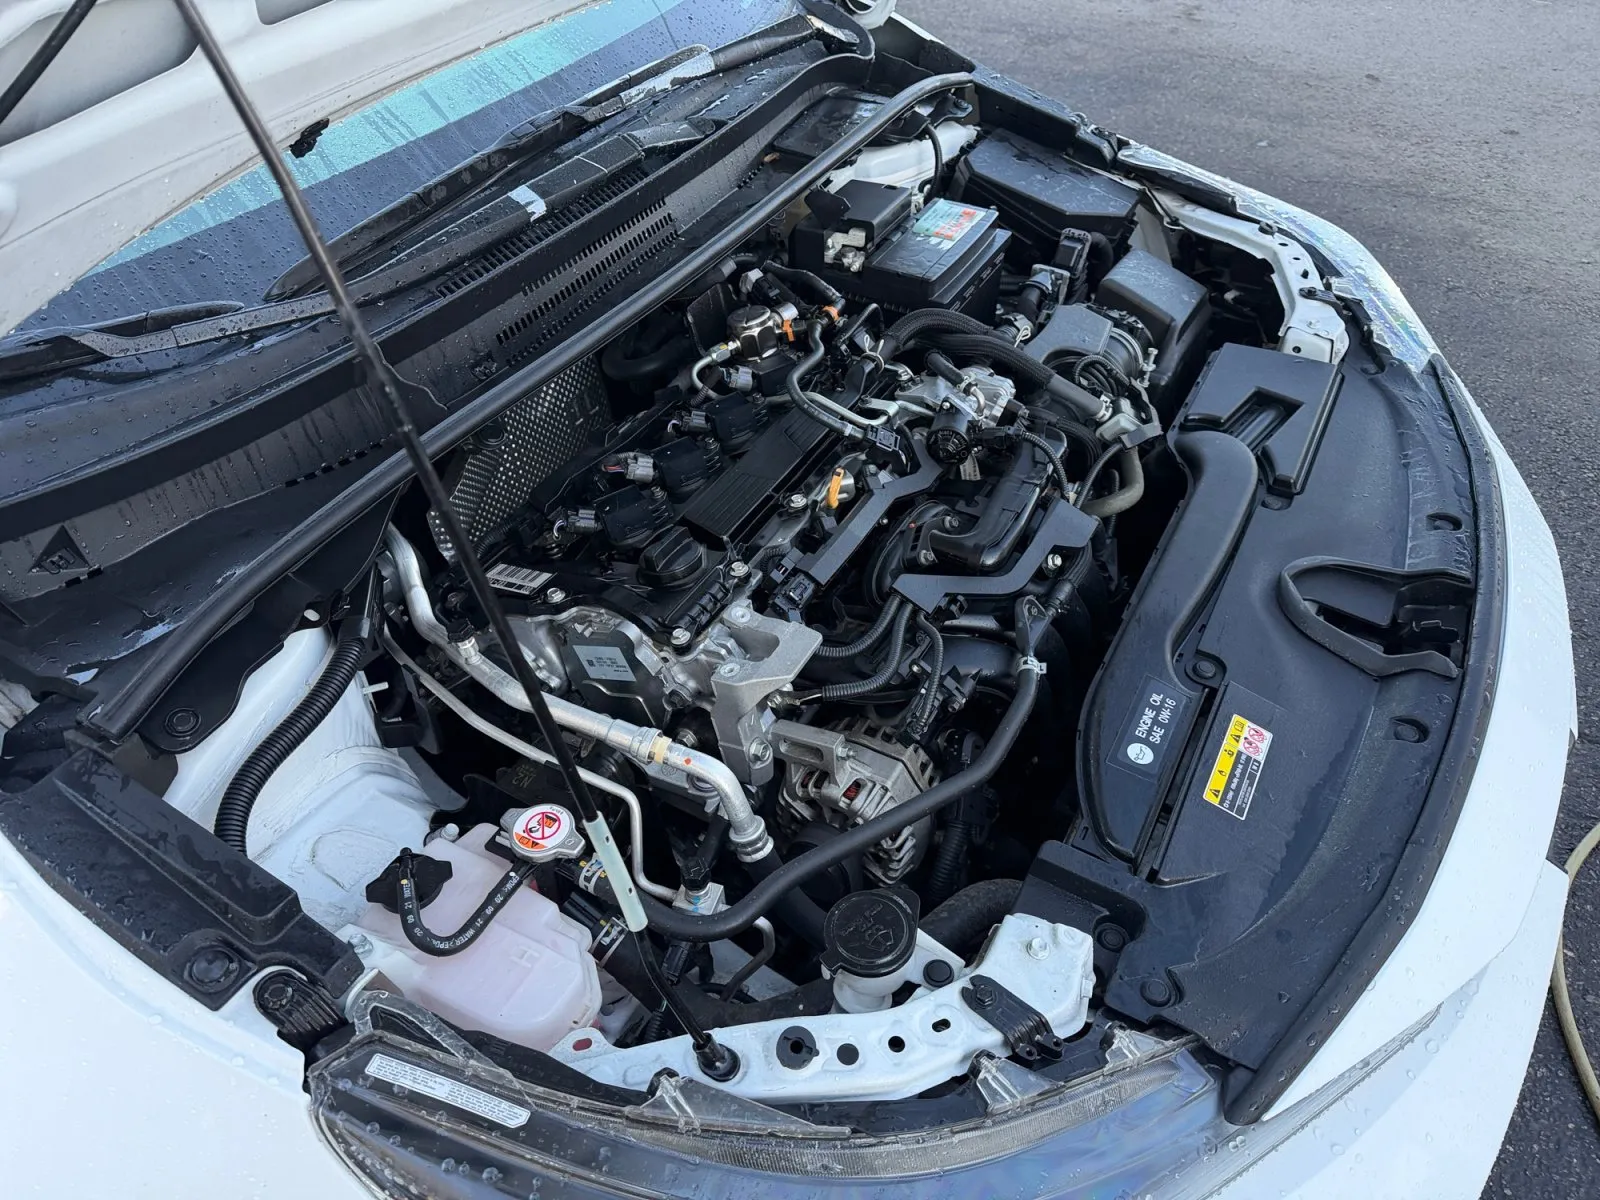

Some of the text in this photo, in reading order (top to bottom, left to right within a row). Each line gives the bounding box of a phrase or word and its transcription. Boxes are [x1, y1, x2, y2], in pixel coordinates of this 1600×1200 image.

[1135, 692, 1164, 739] ENGINE OIL
[1149, 697, 1176, 744] SAE 0W-16
[494, 894, 504, 904] 20
[485, 905, 494, 915] 09
[474, 918, 484, 927] 21
[414, 927, 424, 937] 20
[455, 928, 476, 946] WATER
